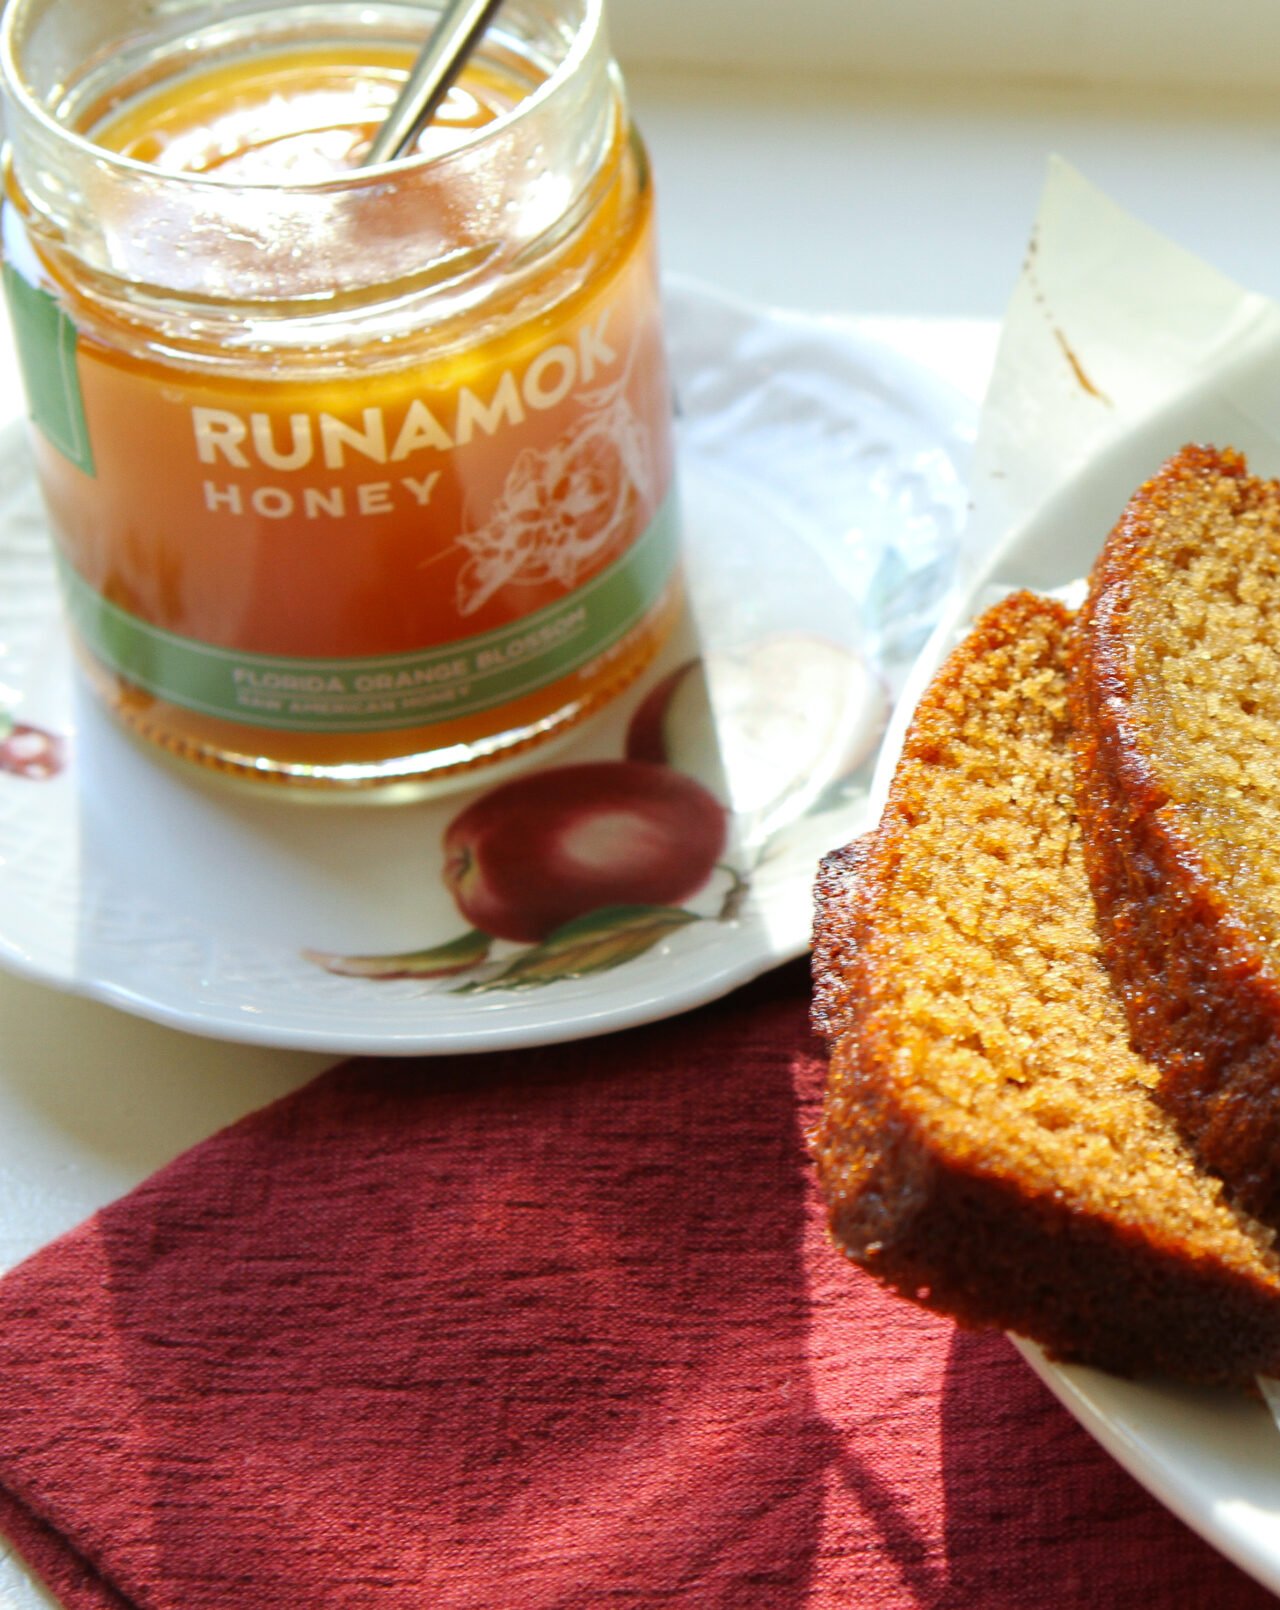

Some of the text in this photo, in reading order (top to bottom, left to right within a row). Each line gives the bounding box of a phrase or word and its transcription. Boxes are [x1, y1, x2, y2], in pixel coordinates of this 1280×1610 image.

[192, 313, 616, 470] RUNAMOK
[204, 472, 441, 518] HONEY
[232, 668, 344, 693] FLORIDA
[355, 660, 466, 692] ORANGE
